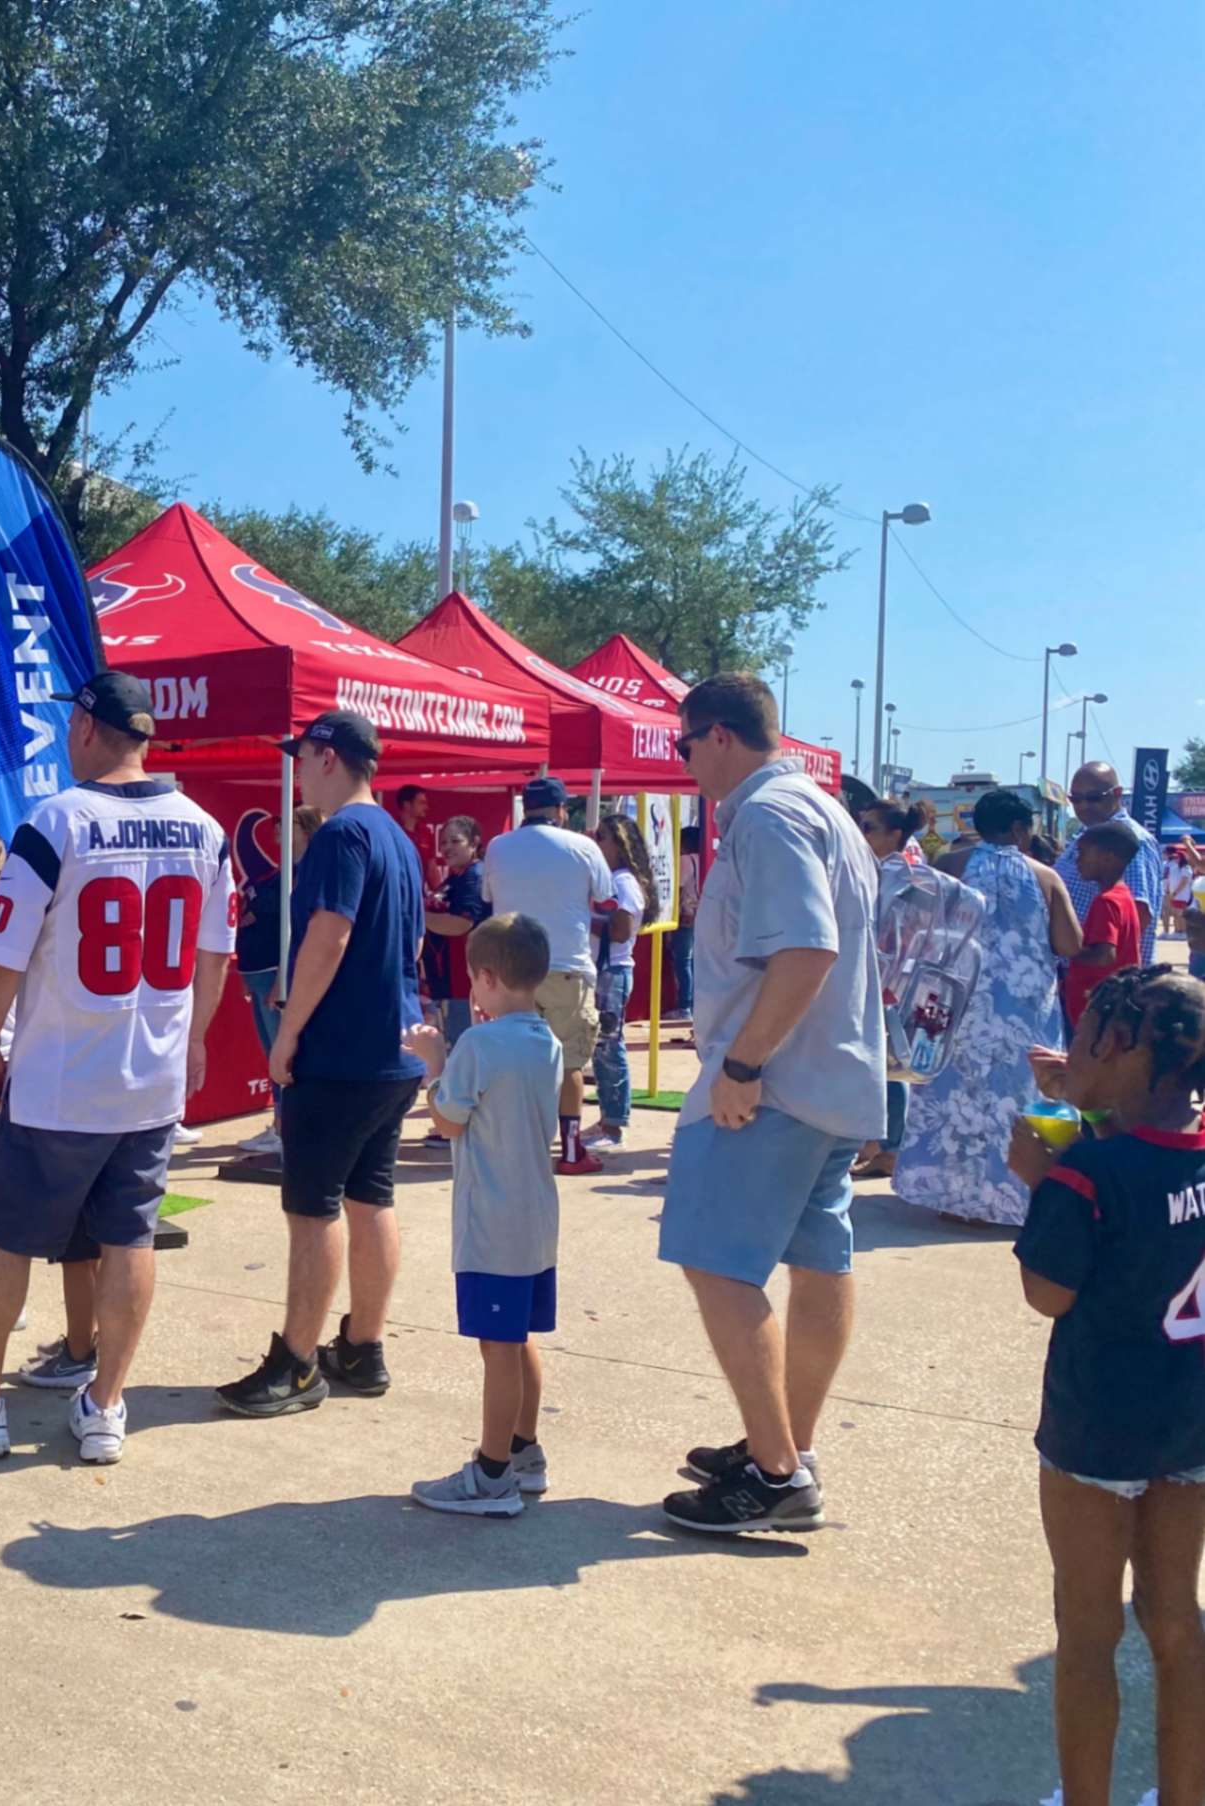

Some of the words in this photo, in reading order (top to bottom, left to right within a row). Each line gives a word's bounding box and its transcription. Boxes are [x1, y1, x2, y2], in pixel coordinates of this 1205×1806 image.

[5, 572, 59, 797] EVENT
[335, 676, 526, 744] HOUSTONTEXANS.COM
[631, 723, 671, 761] TEXANS
[89, 818, 206, 850] A.JOHNSON
[77, 874, 204, 996] 80
